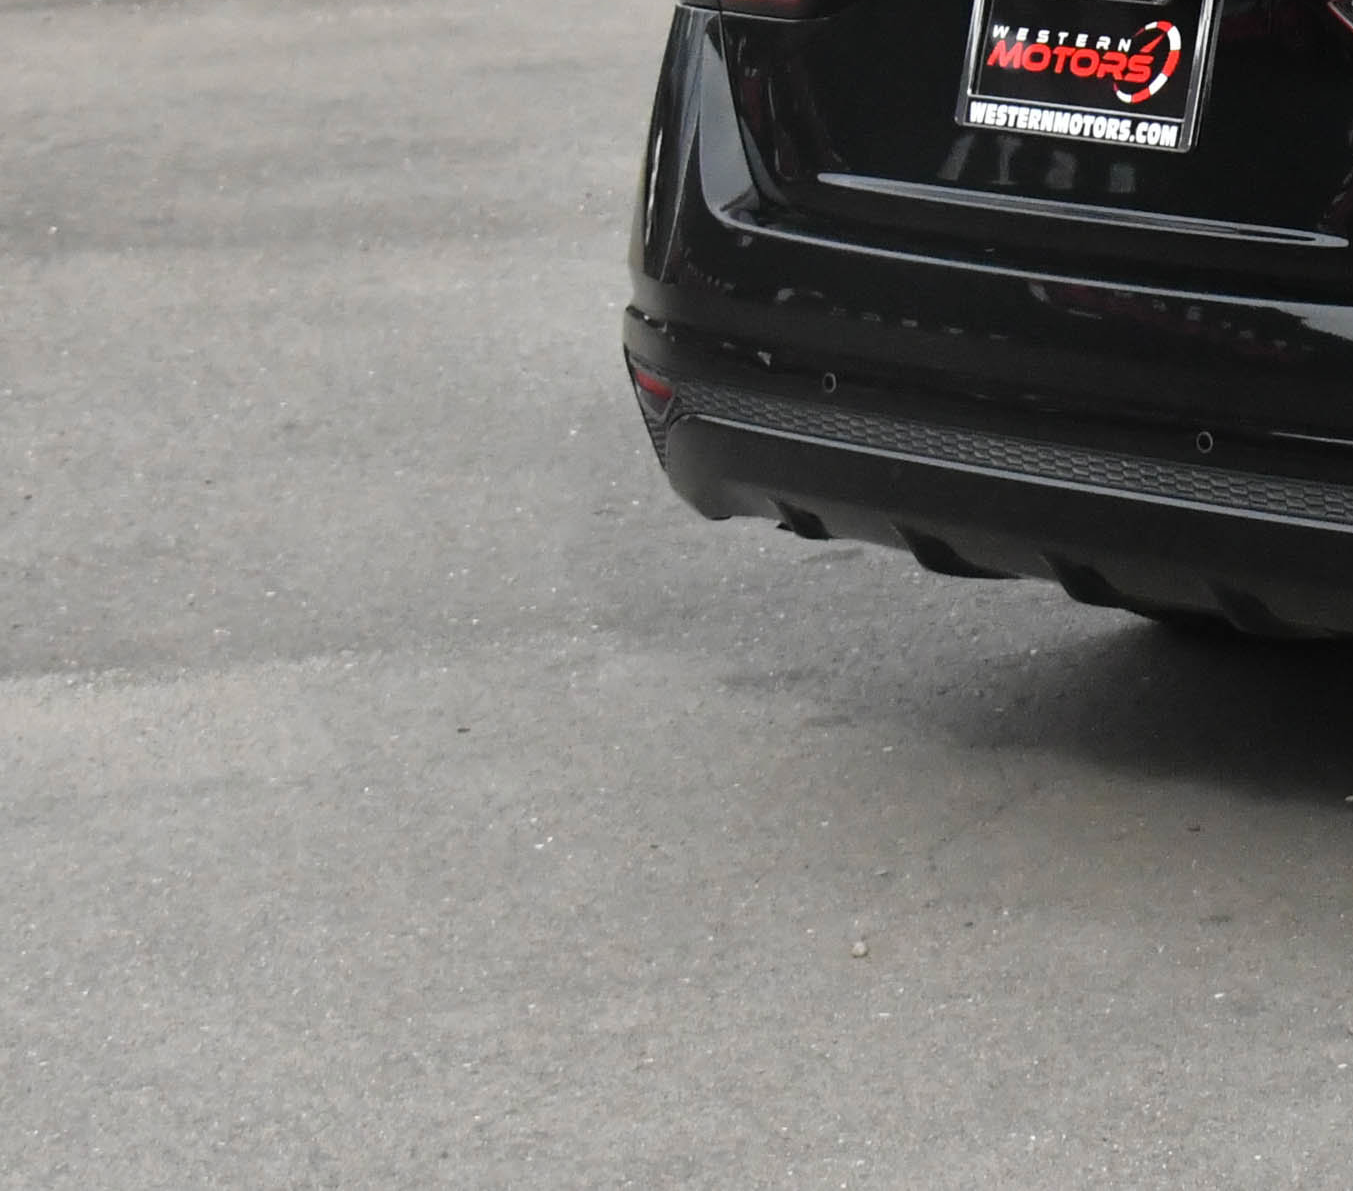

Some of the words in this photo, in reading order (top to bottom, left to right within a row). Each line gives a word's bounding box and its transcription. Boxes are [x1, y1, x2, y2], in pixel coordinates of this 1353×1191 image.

[993, 24, 1132, 53] WESTERN
[987, 39, 1155, 84] MOTORS
[969, 100, 1179, 148] WESTERNMOTORS.COM
